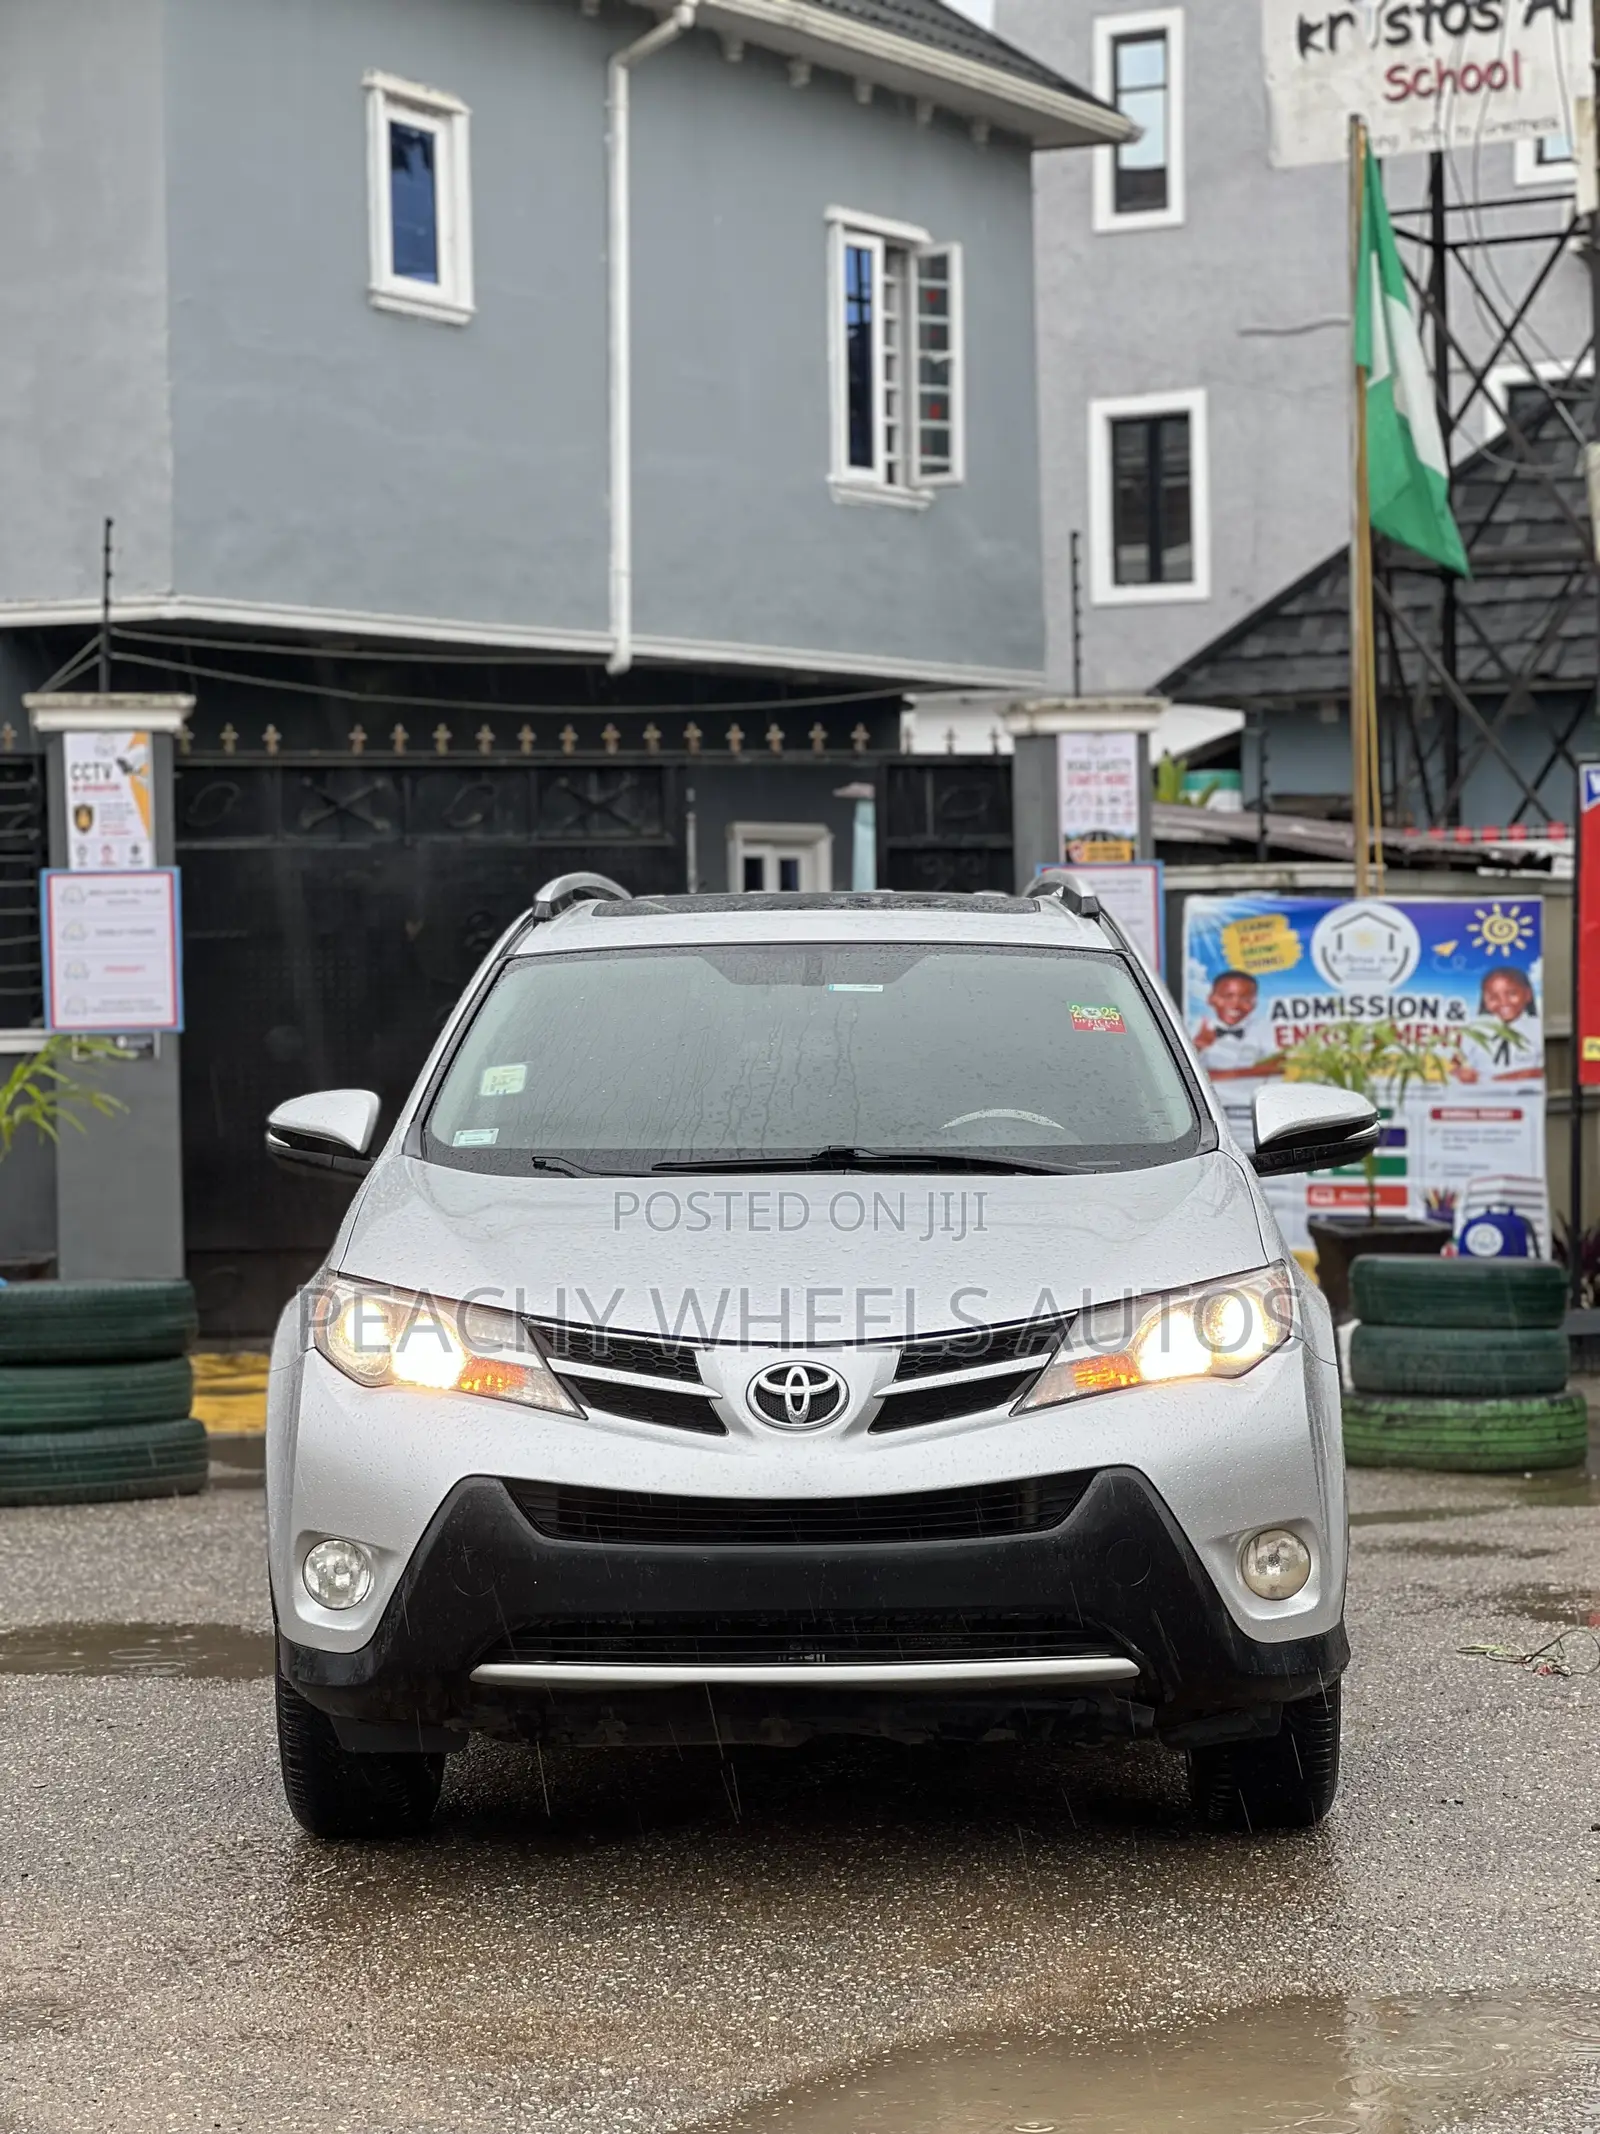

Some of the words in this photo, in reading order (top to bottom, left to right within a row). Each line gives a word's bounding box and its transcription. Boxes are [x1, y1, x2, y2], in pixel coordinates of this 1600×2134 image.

[70, 761, 113, 781] CCTV
[1271, 995, 1438, 1021] ADMISSION
[1446, 1001, 1465, 1021] &
